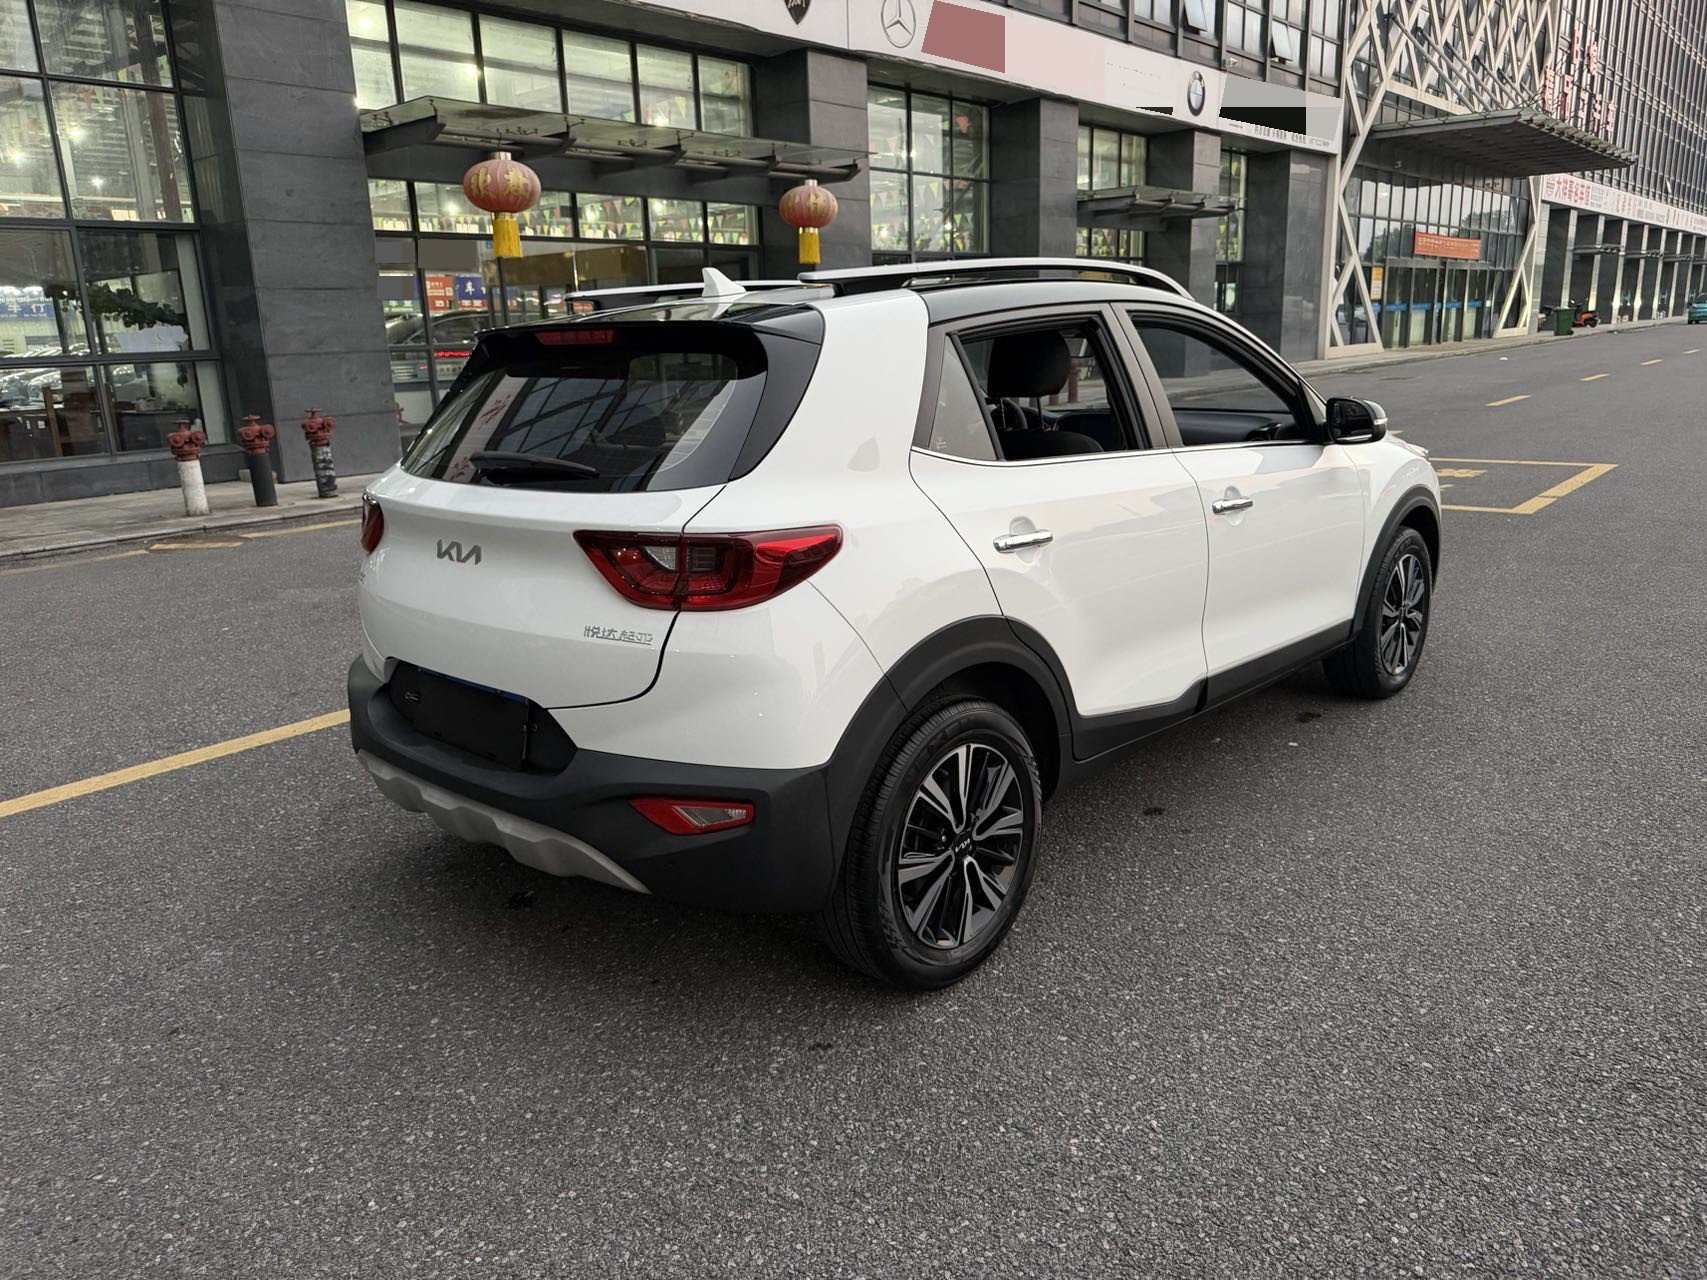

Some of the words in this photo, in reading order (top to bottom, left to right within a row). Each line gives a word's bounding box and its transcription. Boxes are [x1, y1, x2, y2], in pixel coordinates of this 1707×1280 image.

[437, 539, 482, 565] KIA
[584, 625, 653, 645] 悦达起亚
